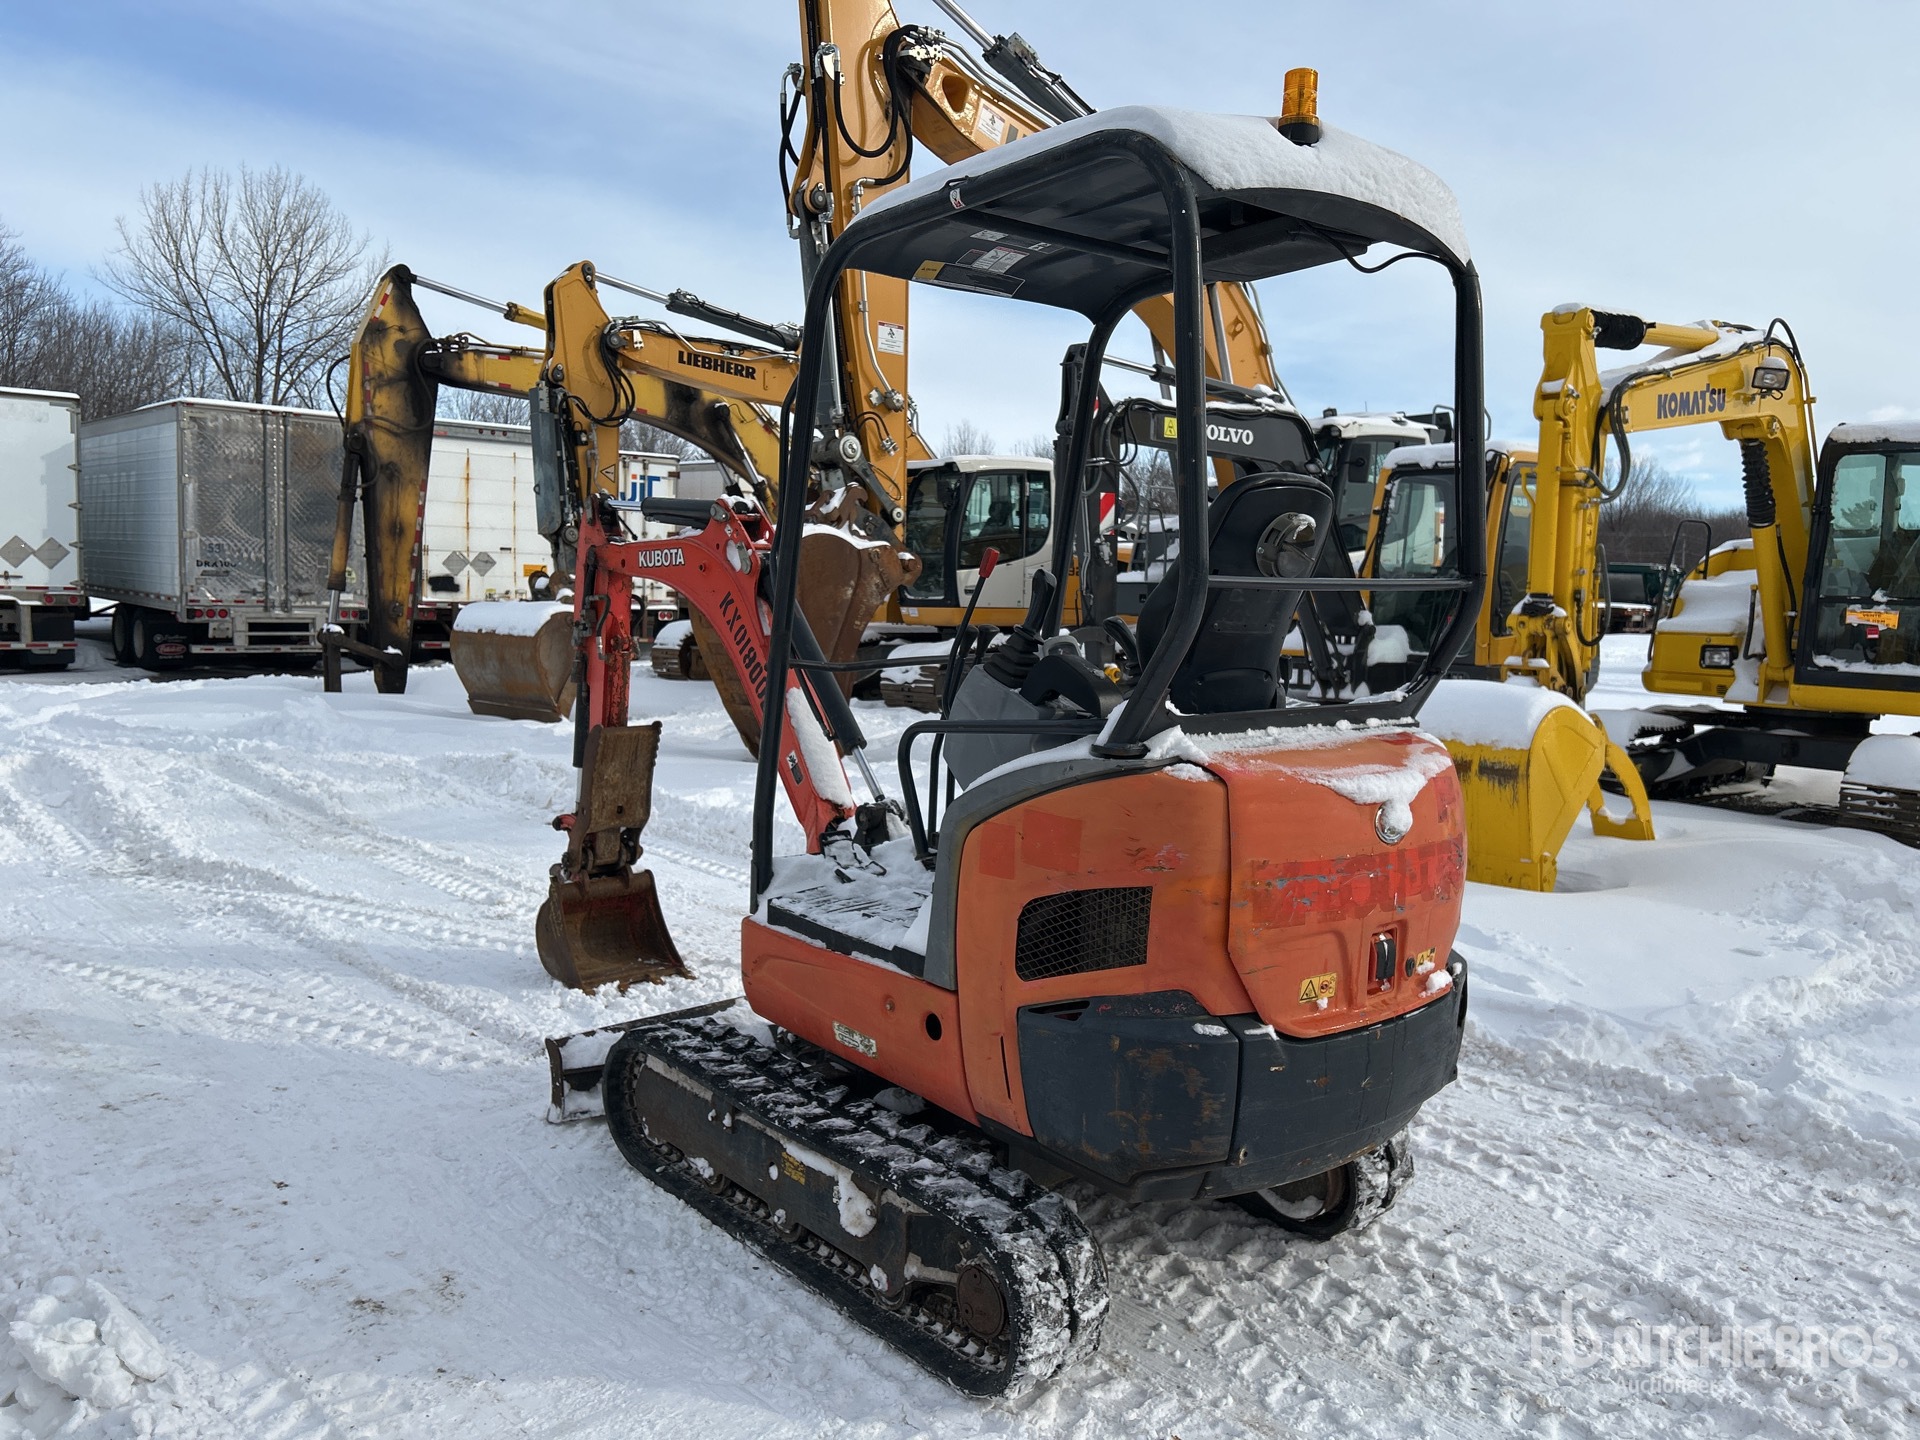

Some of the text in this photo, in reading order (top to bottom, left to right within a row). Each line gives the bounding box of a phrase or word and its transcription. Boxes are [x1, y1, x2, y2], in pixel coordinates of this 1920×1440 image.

[678, 350, 757, 380] LIEBHERR
[1657, 383, 1726, 419] KOMATSU
[1205, 424, 1254, 446] OLVO
[638, 549, 685, 569] KUBOTA
